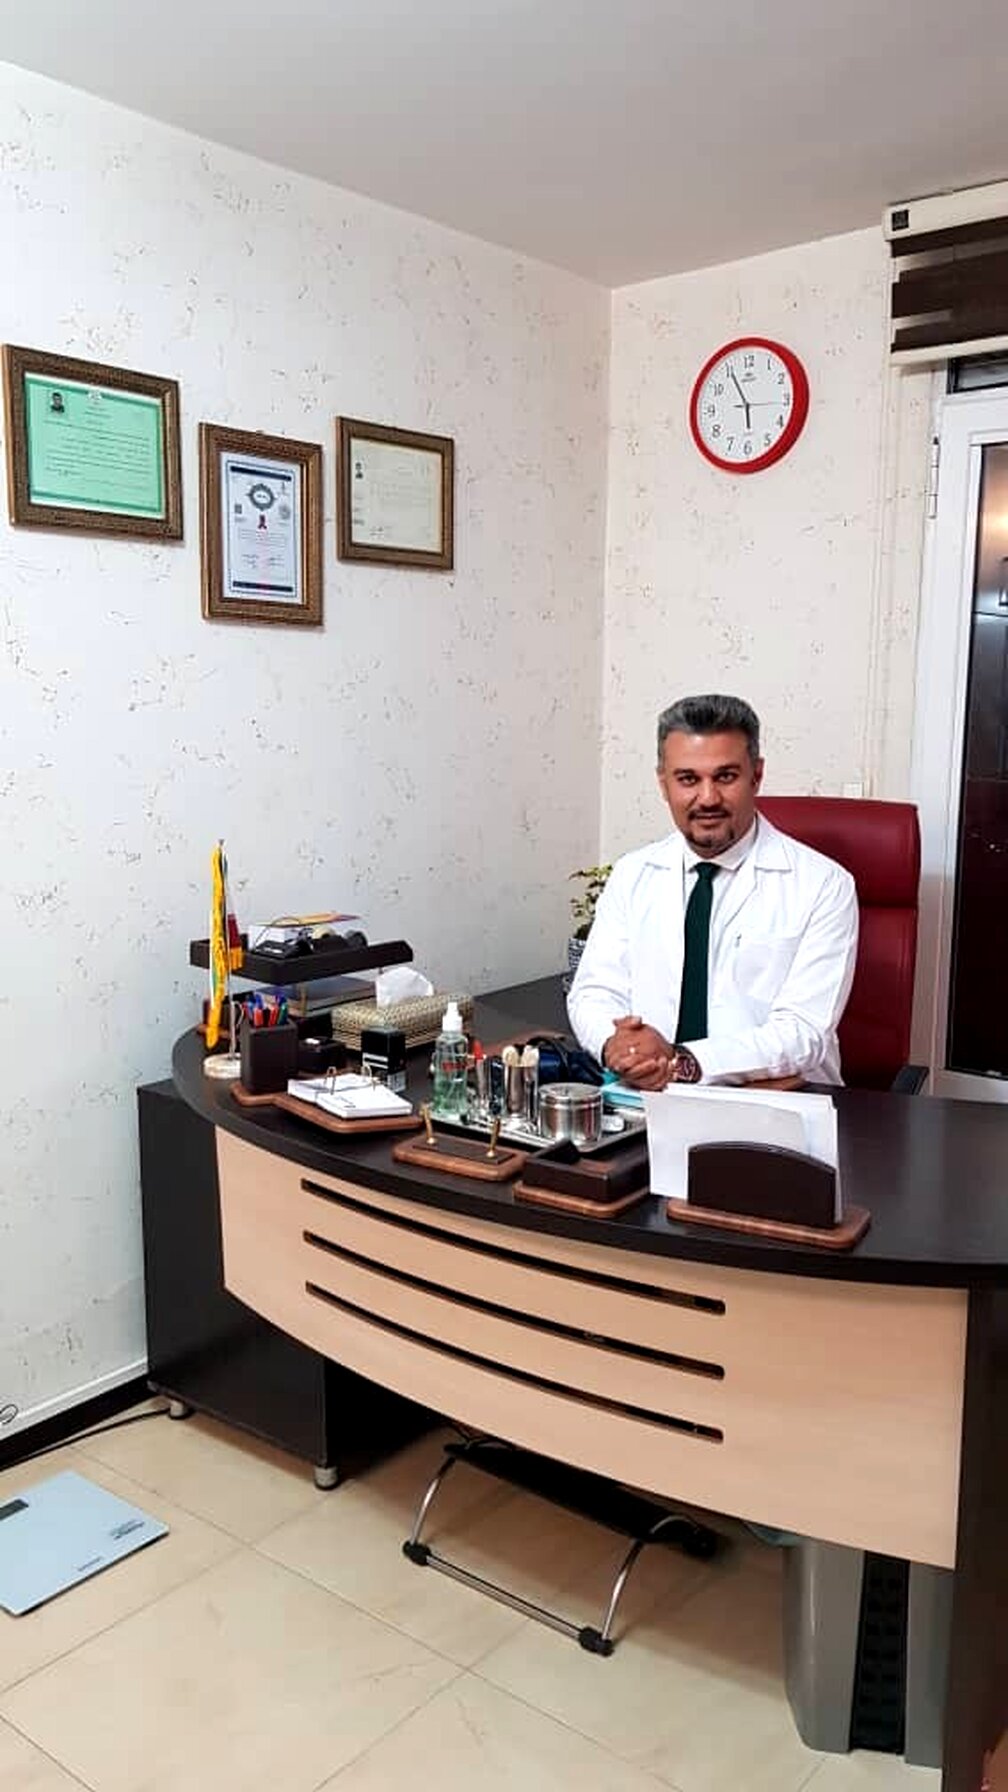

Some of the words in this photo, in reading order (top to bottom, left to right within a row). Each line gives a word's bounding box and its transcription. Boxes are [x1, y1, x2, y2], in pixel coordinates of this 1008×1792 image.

[744, 355, 755, 368] 12
[767, 358, 772, 370] 1
[778, 372, 785, 384] 2
[714, 384, 724, 396] 10
[783, 393, 790, 406] 3
[707, 404, 716, 417] 9
[777, 414, 784, 428] 4
[712, 424, 721, 438] 8
[726, 436, 735, 451] 7
[764, 433, 772, 446] 5
[743, 441, 752, 455] 6
